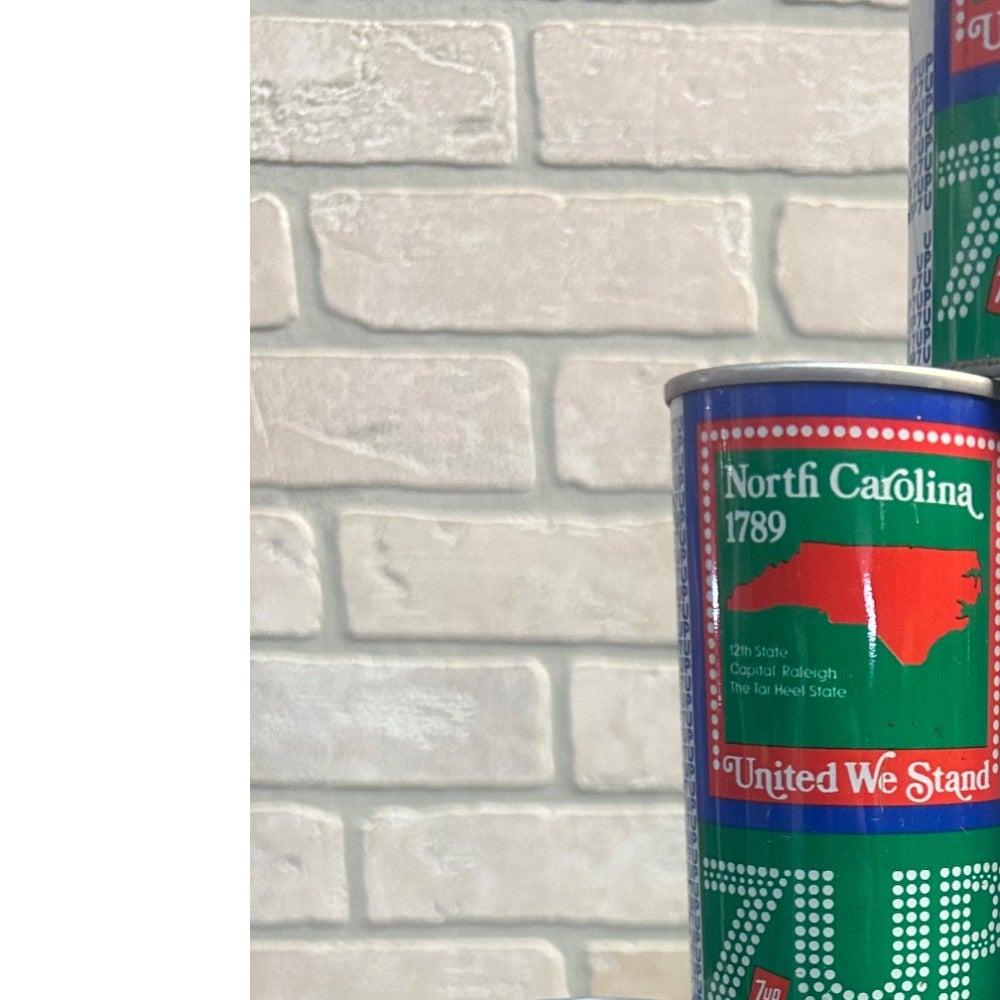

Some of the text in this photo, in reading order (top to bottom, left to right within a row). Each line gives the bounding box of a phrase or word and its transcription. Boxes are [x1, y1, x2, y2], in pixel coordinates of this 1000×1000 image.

[724, 462, 984, 520] North Carolina
[726, 511, 786, 543] 1789
[756, 646, 788, 659] State
[782, 666, 837, 681] Raleigh
[731, 683, 750, 694] The
[775, 685, 805, 697] Heel
[810, 686, 846, 698] State
[723, 751, 990, 802] United We Stand
